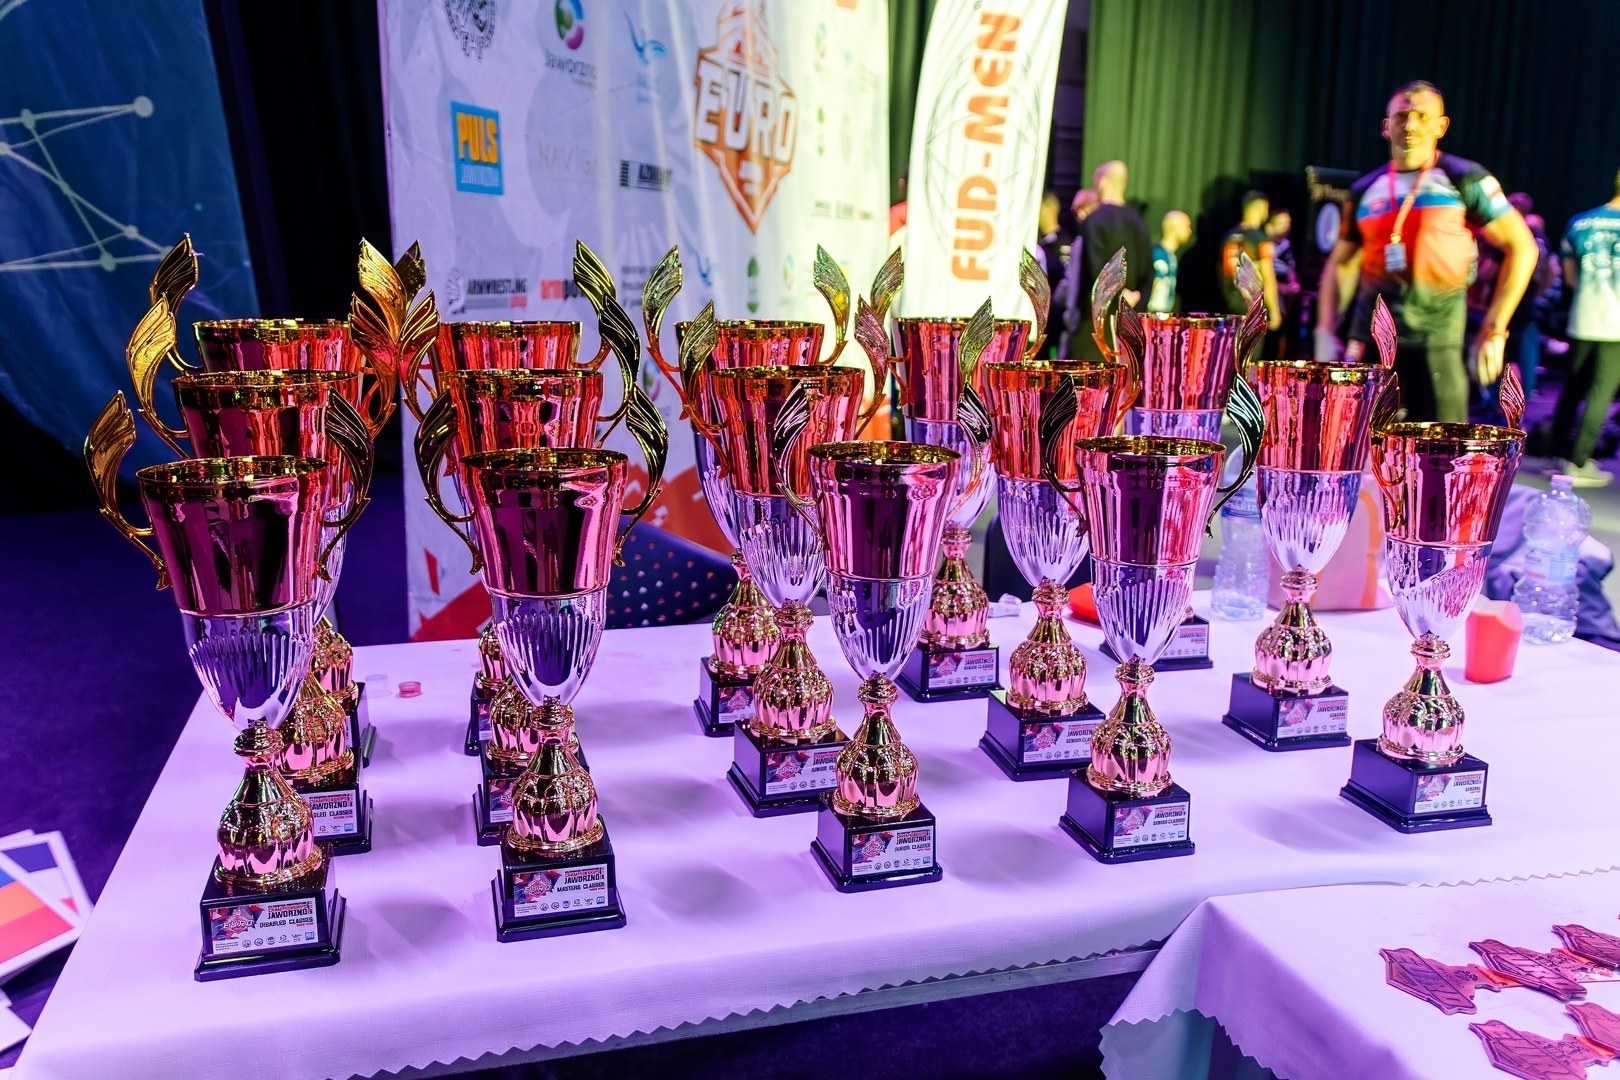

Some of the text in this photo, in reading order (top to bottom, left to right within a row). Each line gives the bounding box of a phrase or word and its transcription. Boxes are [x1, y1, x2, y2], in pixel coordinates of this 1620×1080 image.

[694, 58, 798, 164] EURO
[456, 111, 499, 166] PULS
[951, 12, 1021, 281] FUD-MEN
[311, 800, 347, 811] AWORZNO
[564, 873, 600, 884] JAWORZNO
[557, 884, 581, 892] MASTERS
[583, 882, 605, 890] CLASSES
[267, 908, 308, 920] JAWORZNO
[259, 919, 287, 928] DISABLED
[288, 917, 314, 925] CLASSES
